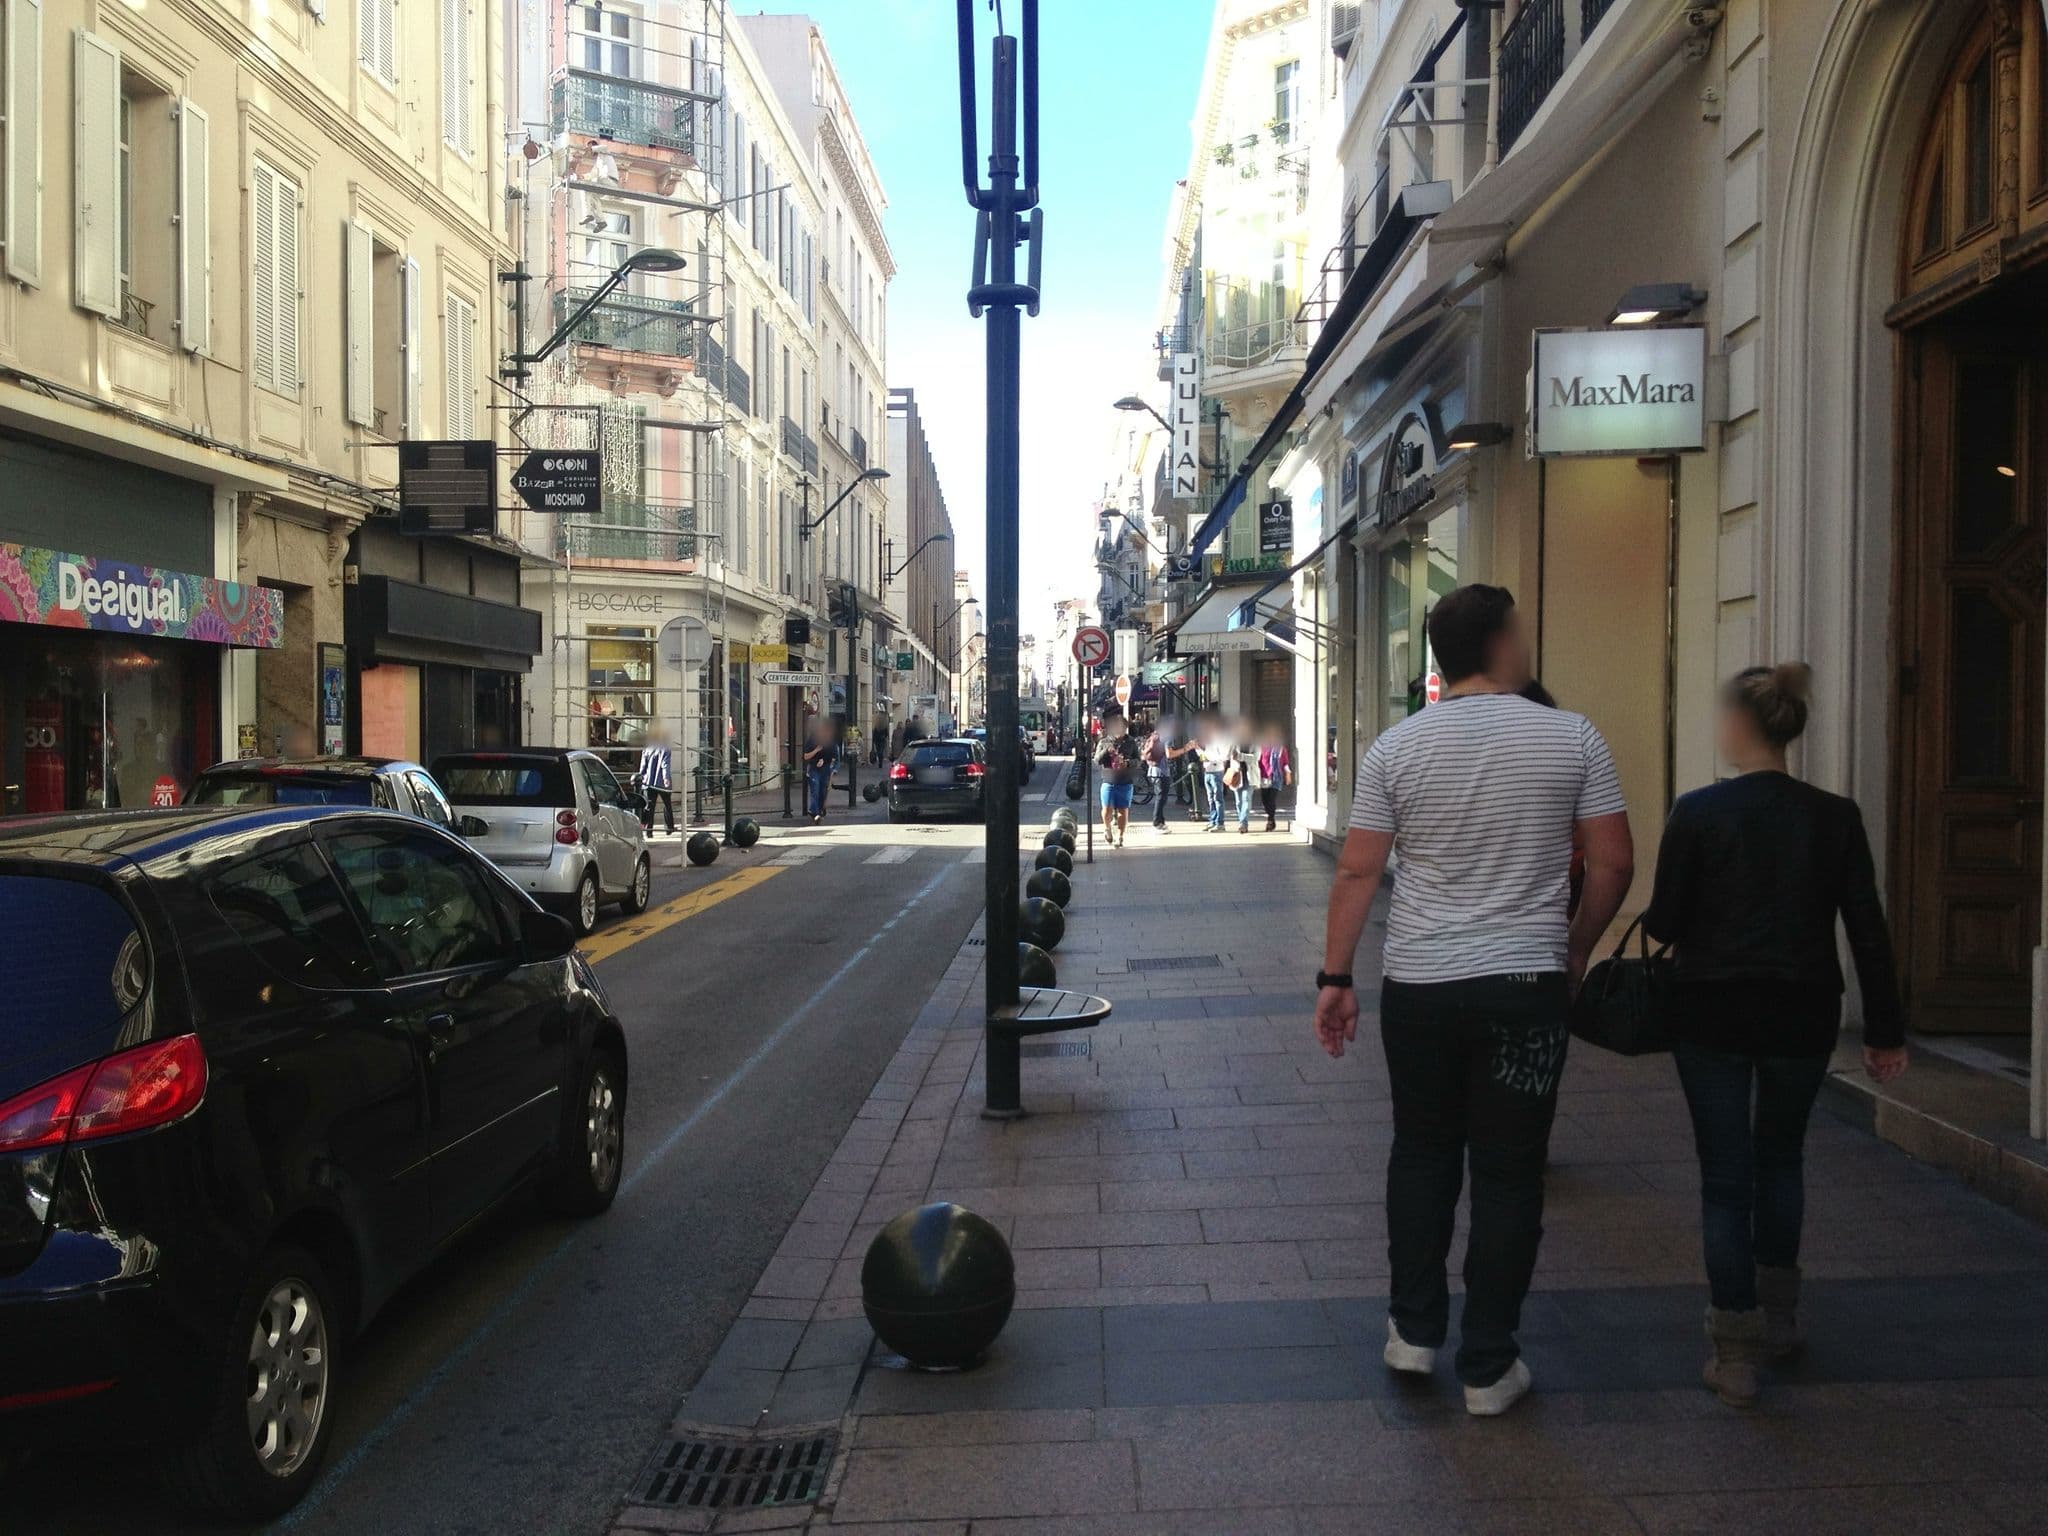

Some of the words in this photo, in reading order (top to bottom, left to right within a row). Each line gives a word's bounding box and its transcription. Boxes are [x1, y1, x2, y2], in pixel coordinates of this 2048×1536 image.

[1549, 373, 1695, 408] MaxMara
[1177, 358, 1196, 493] JULIAN
[543, 458, 588, 471] OGONI
[545, 493, 586, 506] MOSCHINO
[59, 561, 180, 629] Desigual
[578, 592, 663, 614] BOCAGE
[768, 674, 789, 682] CENTRE
[791, 674, 821, 683] CROISETTE
